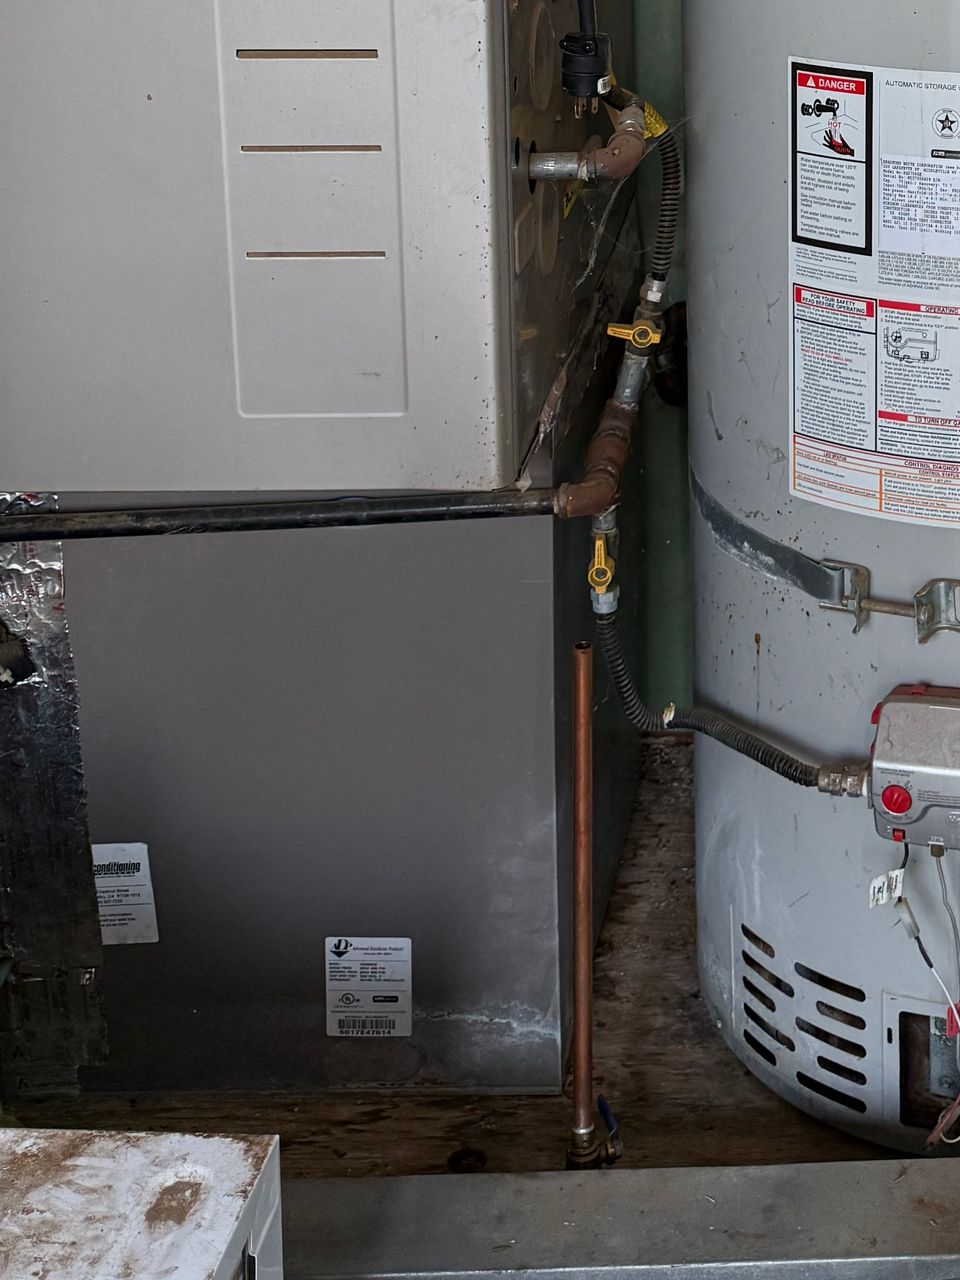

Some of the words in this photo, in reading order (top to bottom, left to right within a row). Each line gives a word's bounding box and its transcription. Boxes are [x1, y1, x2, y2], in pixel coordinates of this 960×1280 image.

[819, 78, 856, 91] DANGER
[885, 80, 922, 89] AUTOMATIC
[925, 83, 957, 91] STORAGE
[822, 295, 835, 303] YOUR
[836, 304, 865, 314] OPERATING
[923, 417, 939, 425] TURN
[904, 460, 930, 469] CONTROL
